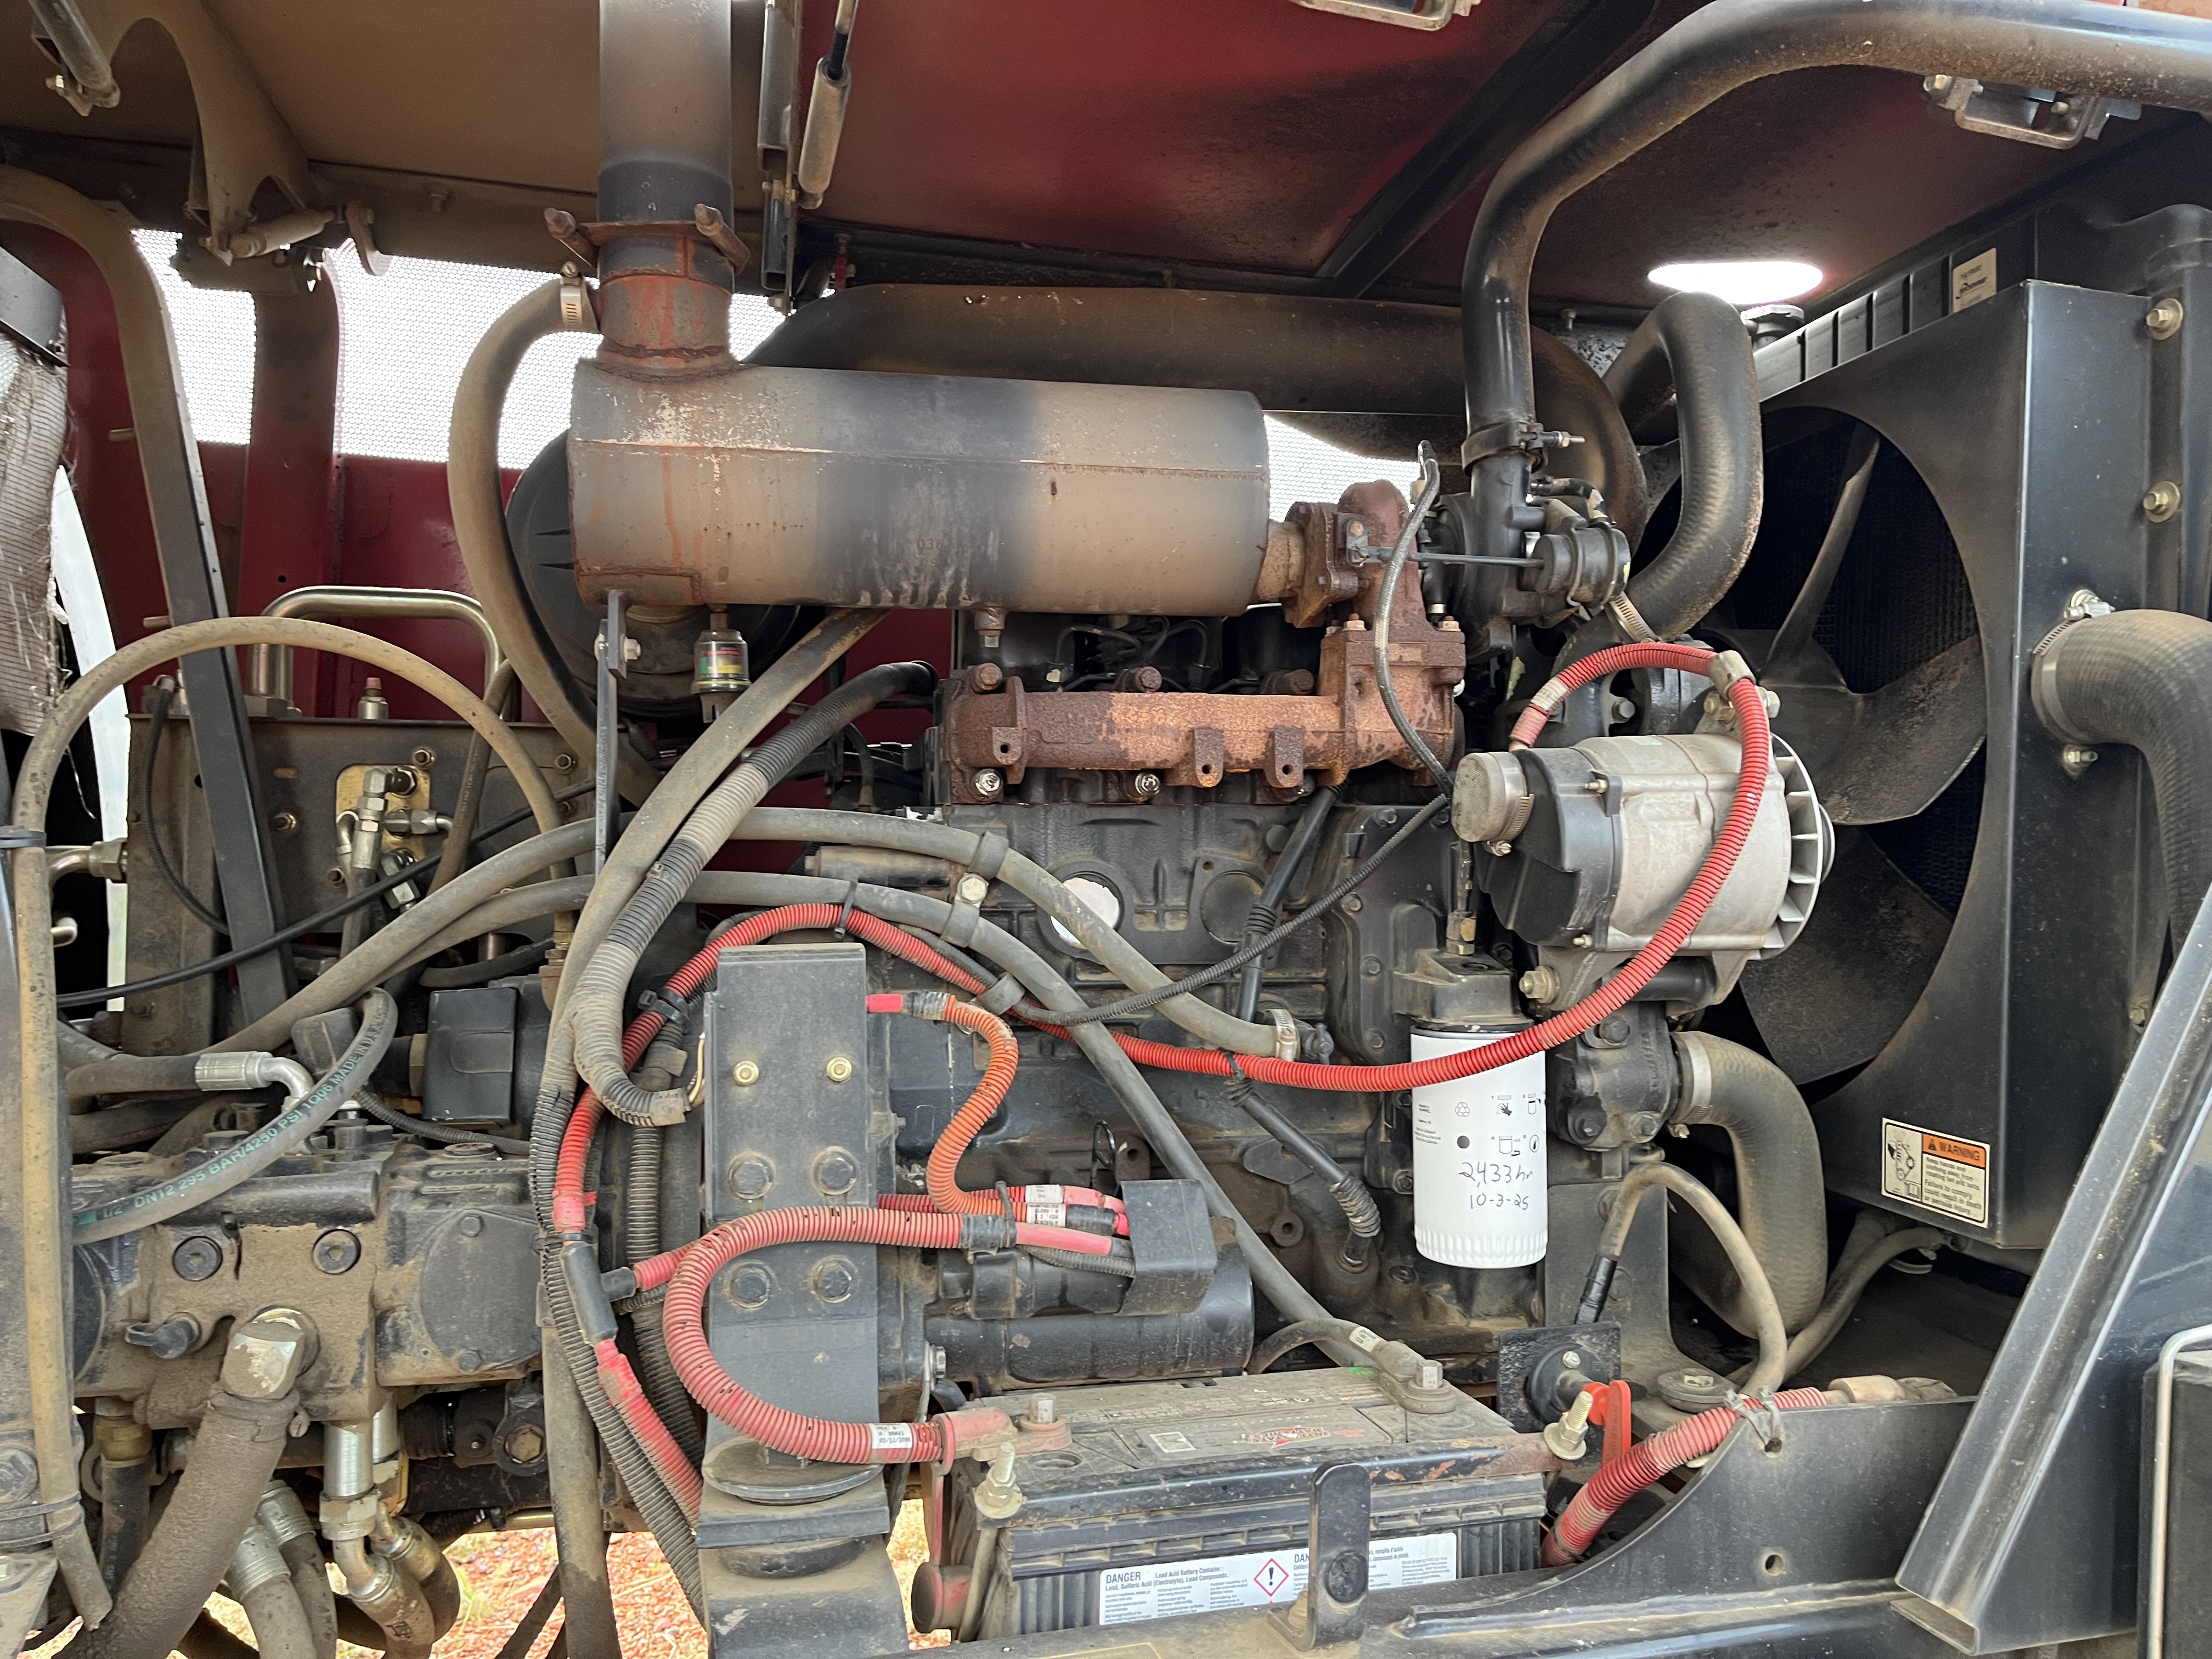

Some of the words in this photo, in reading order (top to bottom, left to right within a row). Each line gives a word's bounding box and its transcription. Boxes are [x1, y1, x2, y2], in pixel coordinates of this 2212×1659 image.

[134, 1185, 176, 1208] DN12
[177, 1170, 206, 1190] 295
[208, 1127, 279, 1175] BAR/4250
[277, 1109, 303, 1130] PSI
[329, 1054, 359, 1084] MADE
[354, 1045, 369, 1057] IN
[1939, 1141, 1980, 1161] WARNING
[1470, 1193, 1529, 1211] 10-3-25
[1106, 1571, 1141, 1584] DANGER
